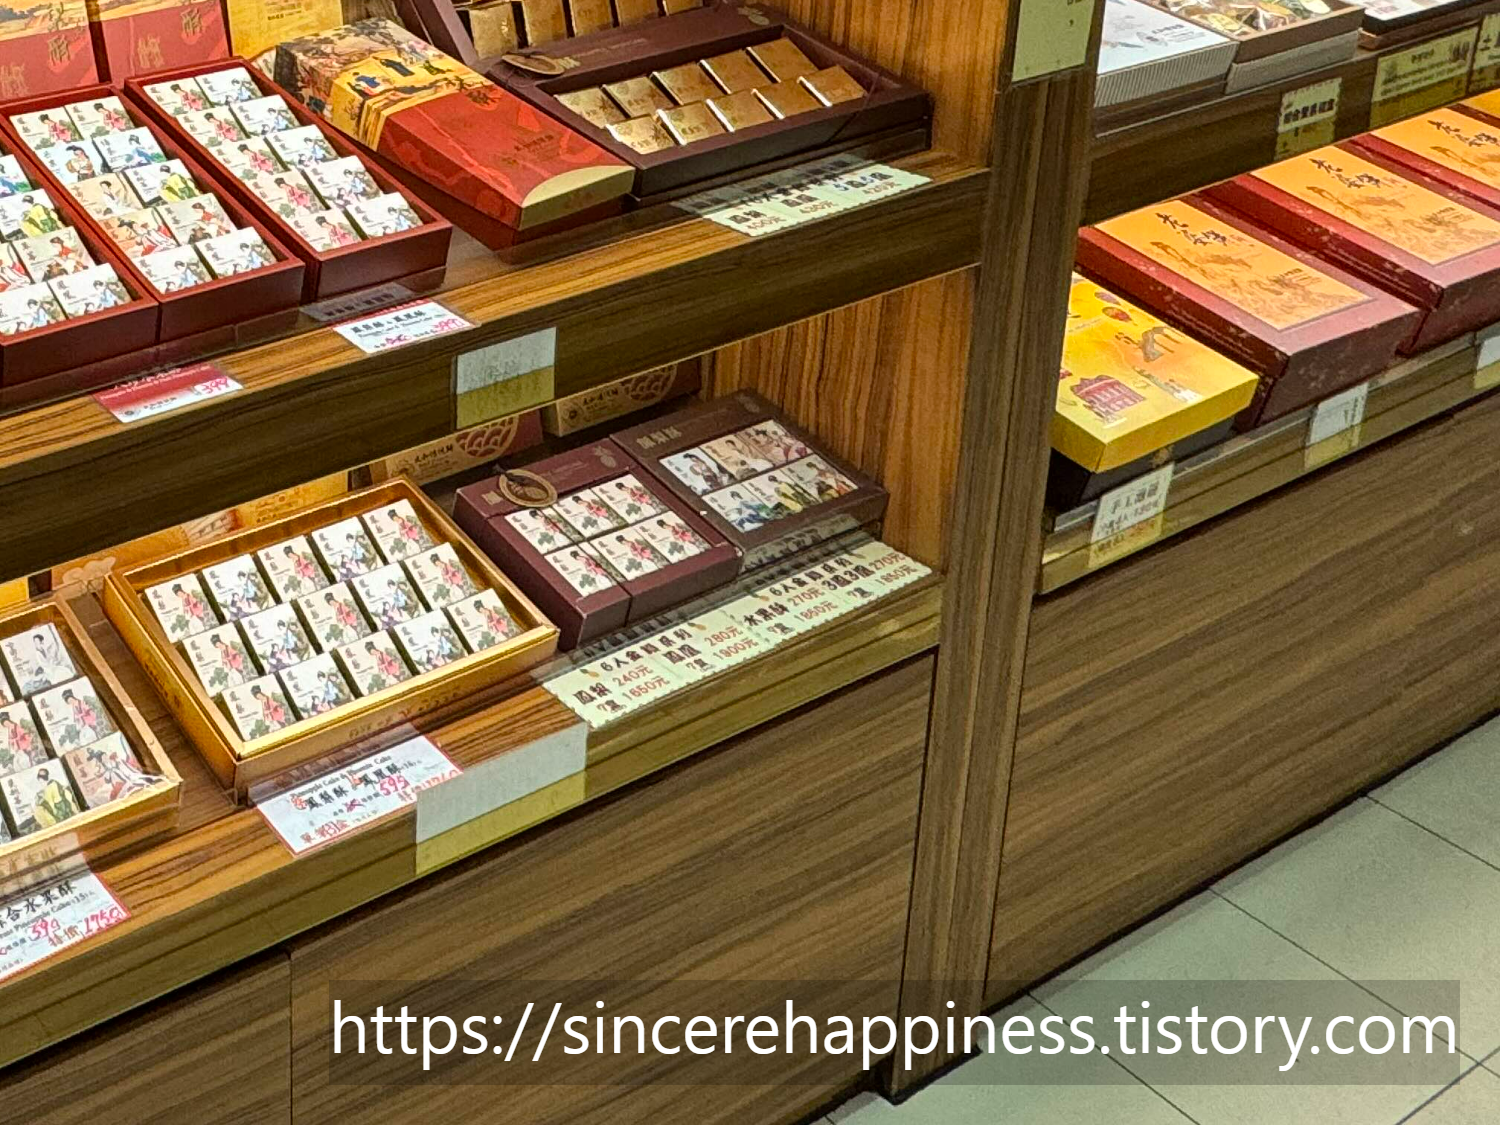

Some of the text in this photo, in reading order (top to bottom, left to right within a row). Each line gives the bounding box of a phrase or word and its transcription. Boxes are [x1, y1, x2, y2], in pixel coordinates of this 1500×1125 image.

[703, 625, 744, 647] 280元
[712, 638, 759, 661] 1900元
[612, 666, 654, 687] 240元
[374, 755, 392, 766] Cake
[51, 900, 72, 914] Cake
